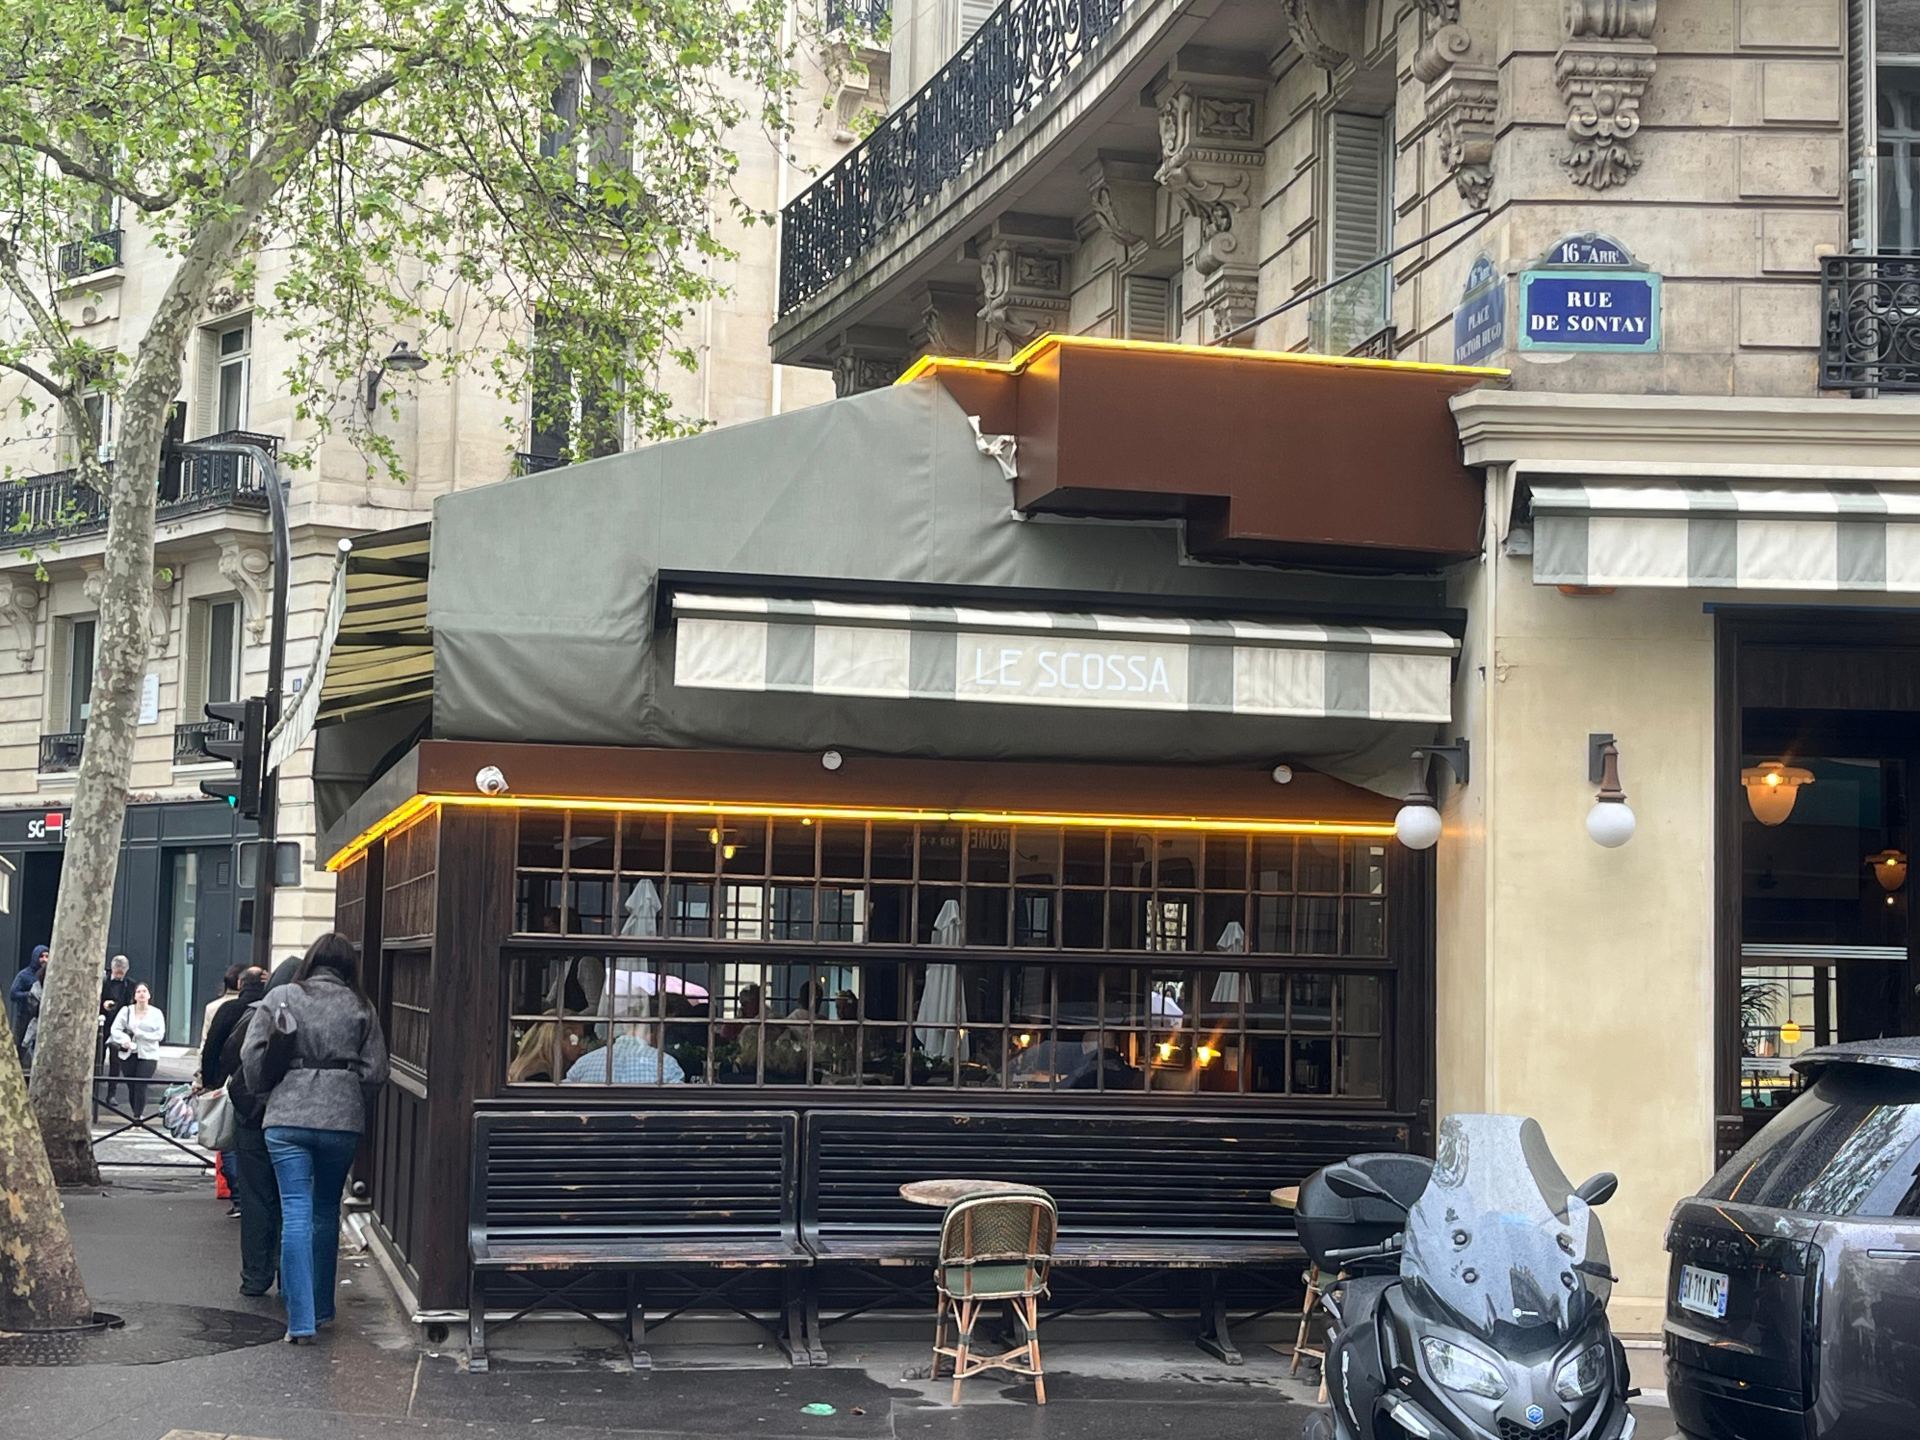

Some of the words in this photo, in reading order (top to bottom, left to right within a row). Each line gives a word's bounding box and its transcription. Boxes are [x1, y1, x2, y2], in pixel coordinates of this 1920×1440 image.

[1567, 291, 1612, 308] RUE
[1468, 304, 1490, 332] PLACE
[1531, 314, 1559, 331] DE
[1567, 314, 1646, 332] SONTAY
[1456, 334, 1481, 362] VICTOR
[975, 647, 1023, 687] LE
[1038, 651, 1170, 693] SCOSSA
[28, 820, 45, 838] SG
